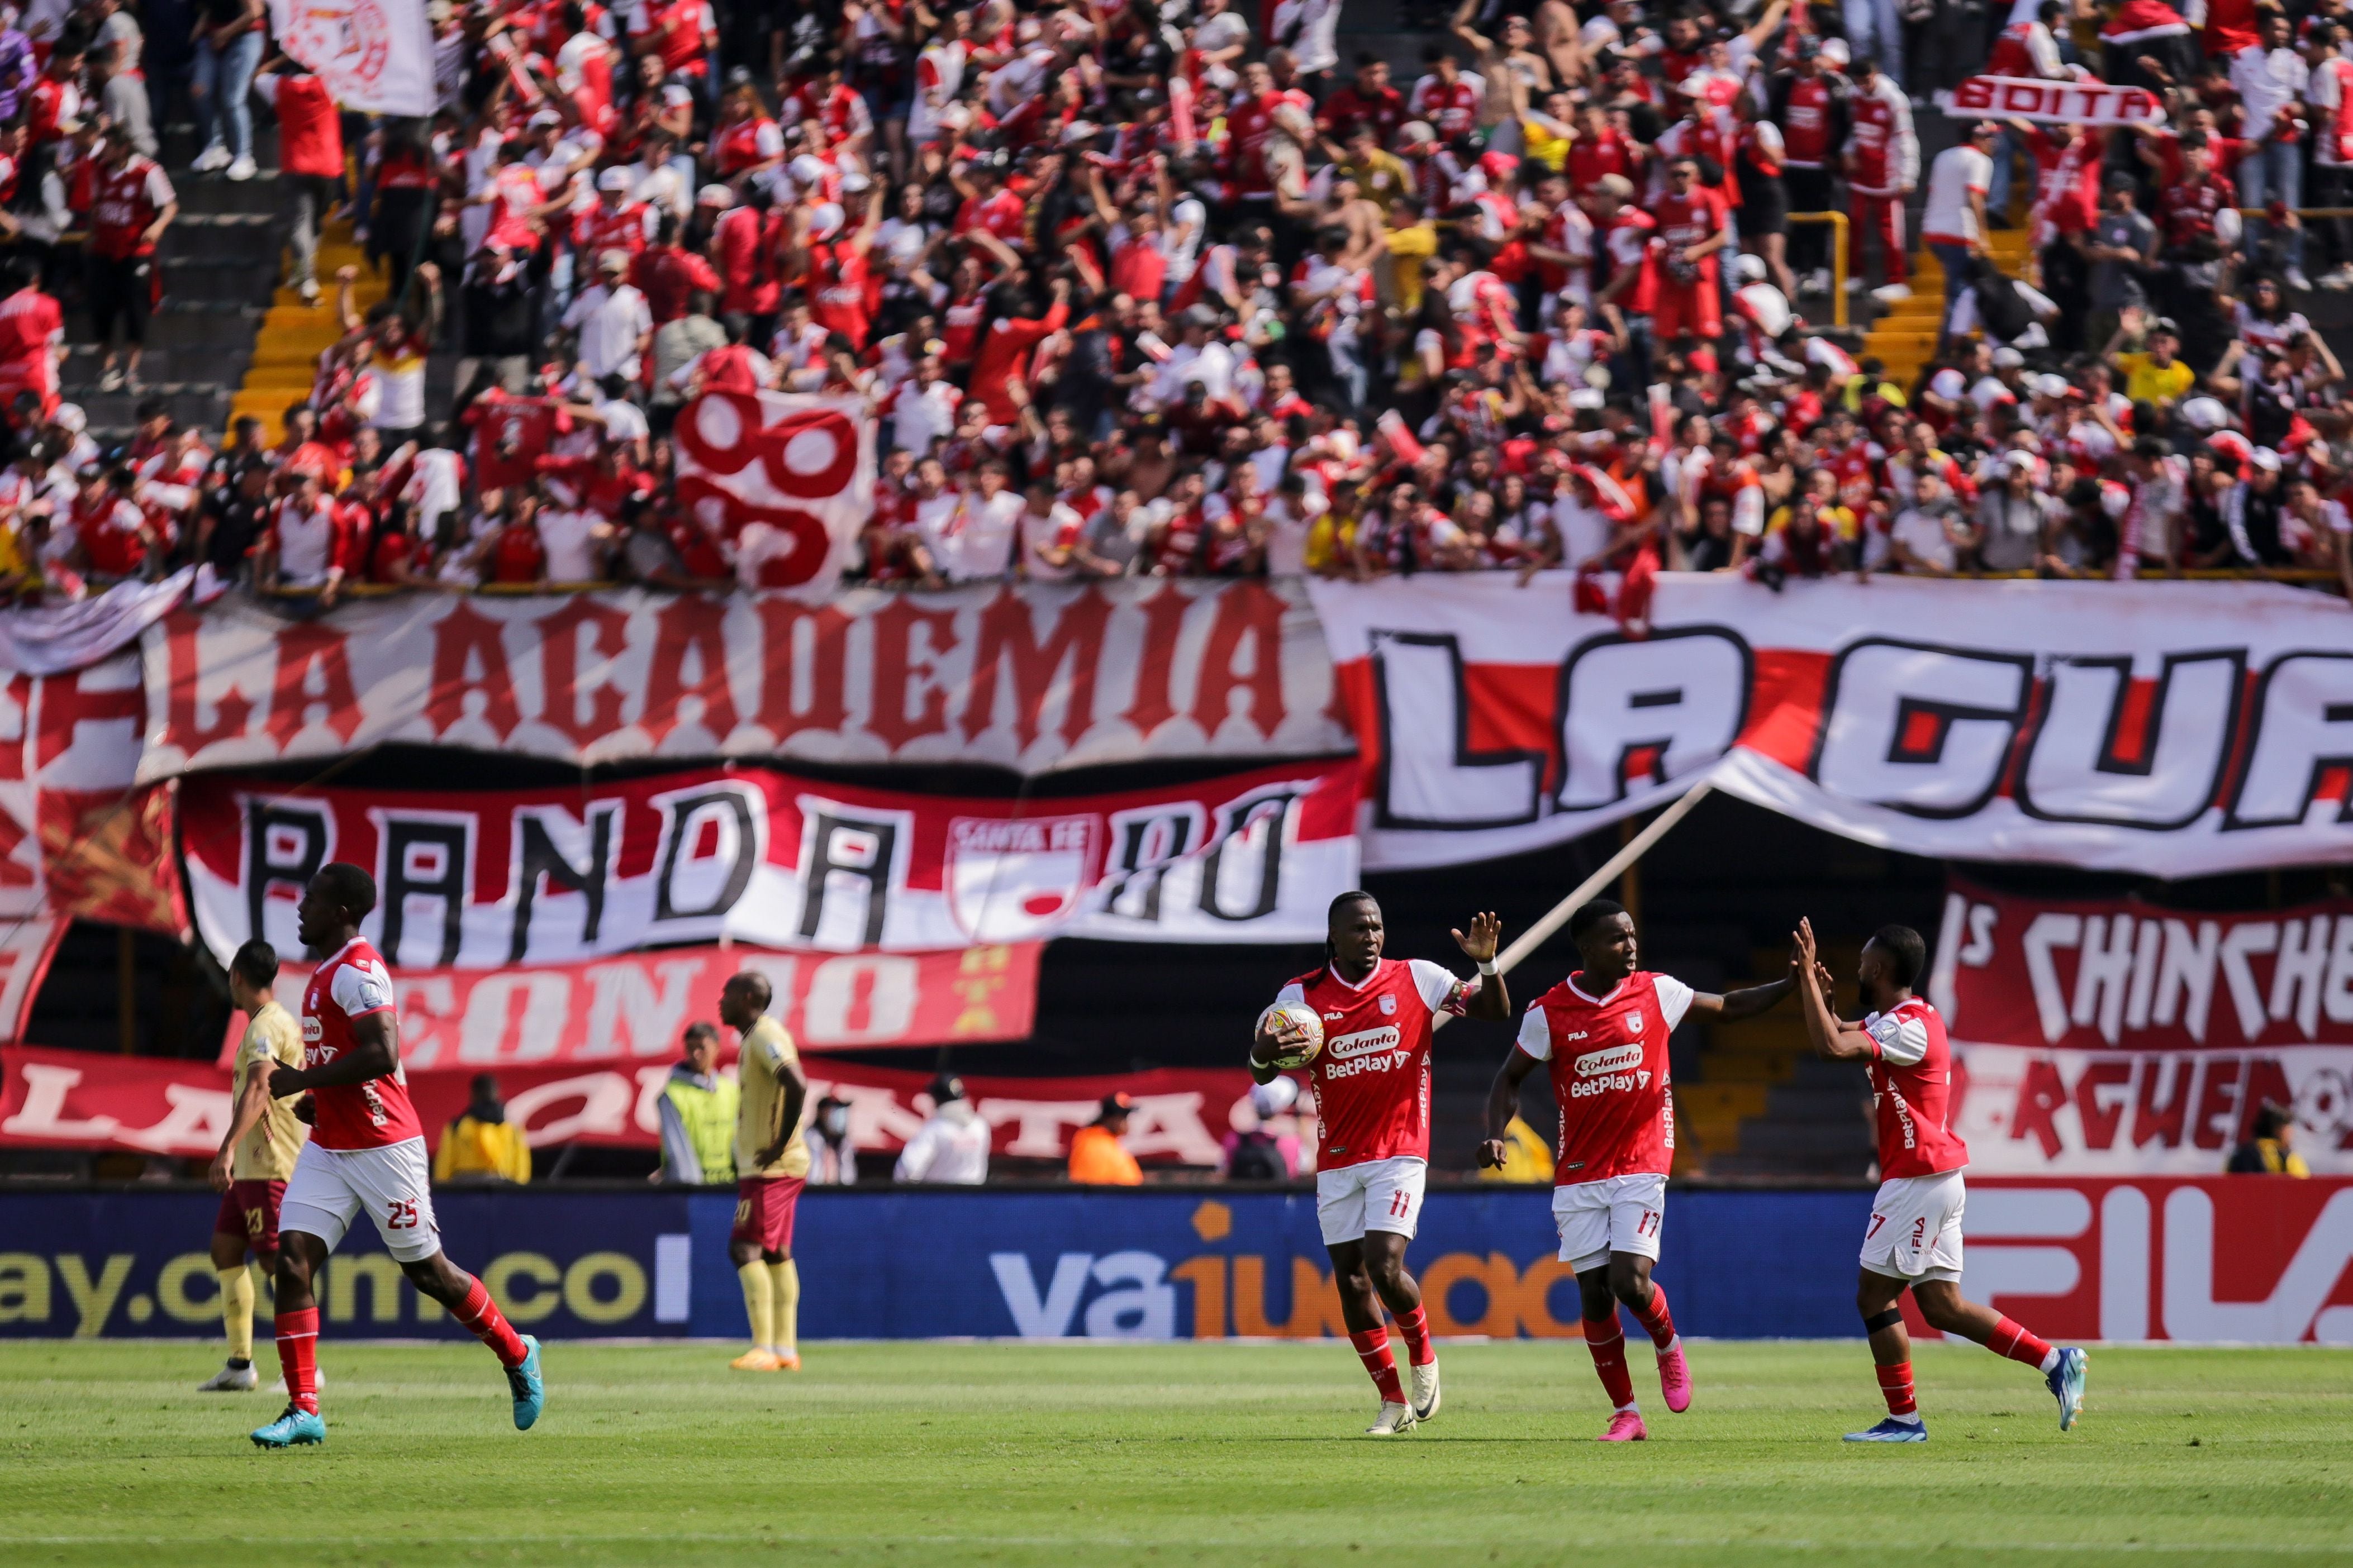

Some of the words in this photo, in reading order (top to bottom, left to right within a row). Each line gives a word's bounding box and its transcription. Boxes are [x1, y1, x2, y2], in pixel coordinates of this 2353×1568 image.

[165, 610, 364, 753] LA
[424, 578, 1290, 757] ACADEMIA
[1368, 625, 1755, 831] LA
[954, 821, 1044, 850] SANTA
[1049, 818, 1087, 848] FE
[1324, 1012, 1343, 1021] FILA
[1330, 1033, 1397, 1054] Colanta
[1568, 1031, 1588, 1041] FILA
[1325, 1055, 1391, 1080] BetPlay
[1576, 1051, 1641, 1071] Colanta
[1571, 1073, 1635, 1098] BetPlay
[1662, 1088, 1675, 1149] BetPlay
[1891, 1091, 1915, 1149] BetPlay
[387, 1198, 417, 1229] 25
[1390, 1189, 1410, 1218] 11
[1637, 1209, 1660, 1238] 17
[1911, 1216, 1925, 1247] FILA
